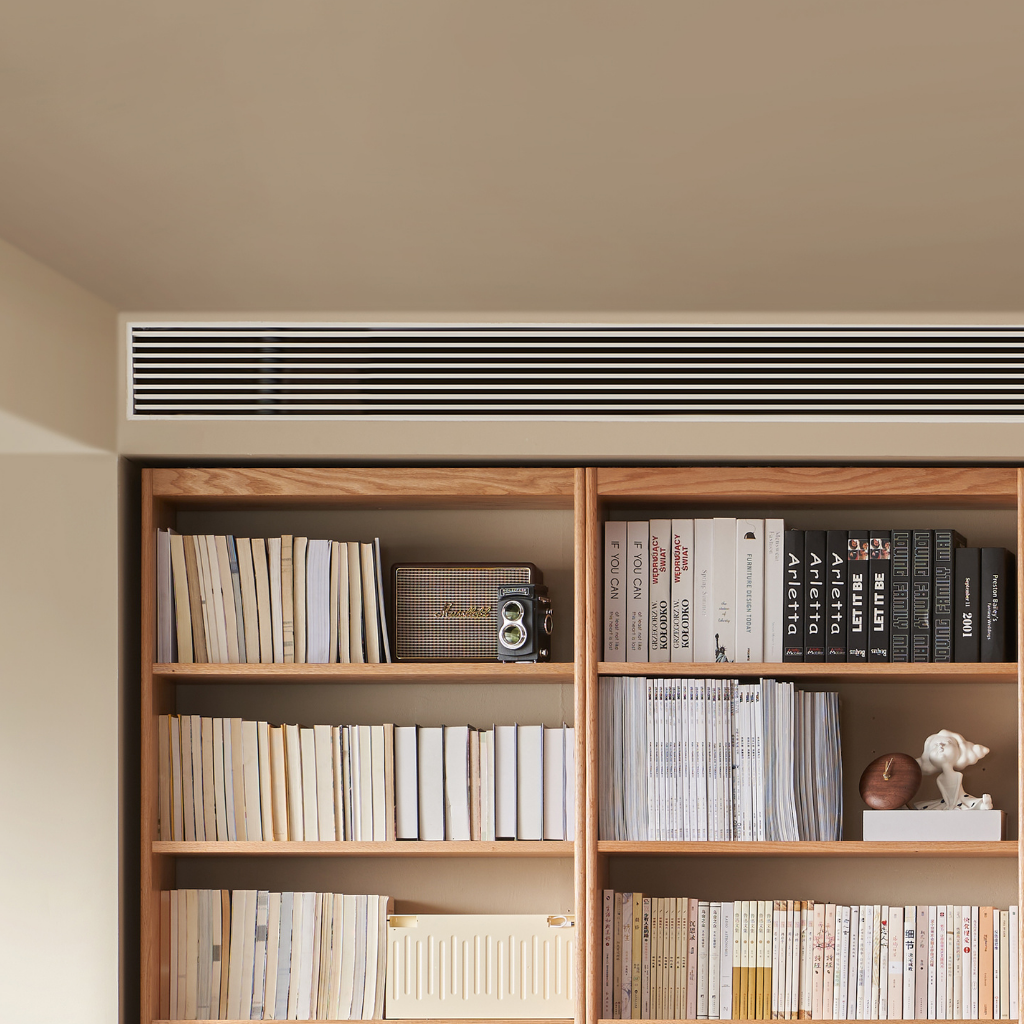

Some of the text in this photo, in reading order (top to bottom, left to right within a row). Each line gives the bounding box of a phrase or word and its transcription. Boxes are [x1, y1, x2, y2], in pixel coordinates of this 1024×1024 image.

[610, 541, 620, 600] IF YOU CAN
[634, 542, 642, 600] IF YOU CAN
[681, 546, 689, 571] ŚWIAT
[788, 552, 800, 634] Arletta
[809, 552, 822, 634] Arletta
[831, 552, 844, 634] Arletta
[852, 574, 862, 632] LET IT BE
[874, 573, 884, 631] LET IT BE
[893, 582, 908, 629] FAMILY
[914, 582, 929, 629] FAMILY
[660, 600, 668, 650] KOŁODKO
[681, 599, 690, 648] KOŁODKO
[962, 612, 972, 637] 2001
[905, 930, 914, 950] 细节
